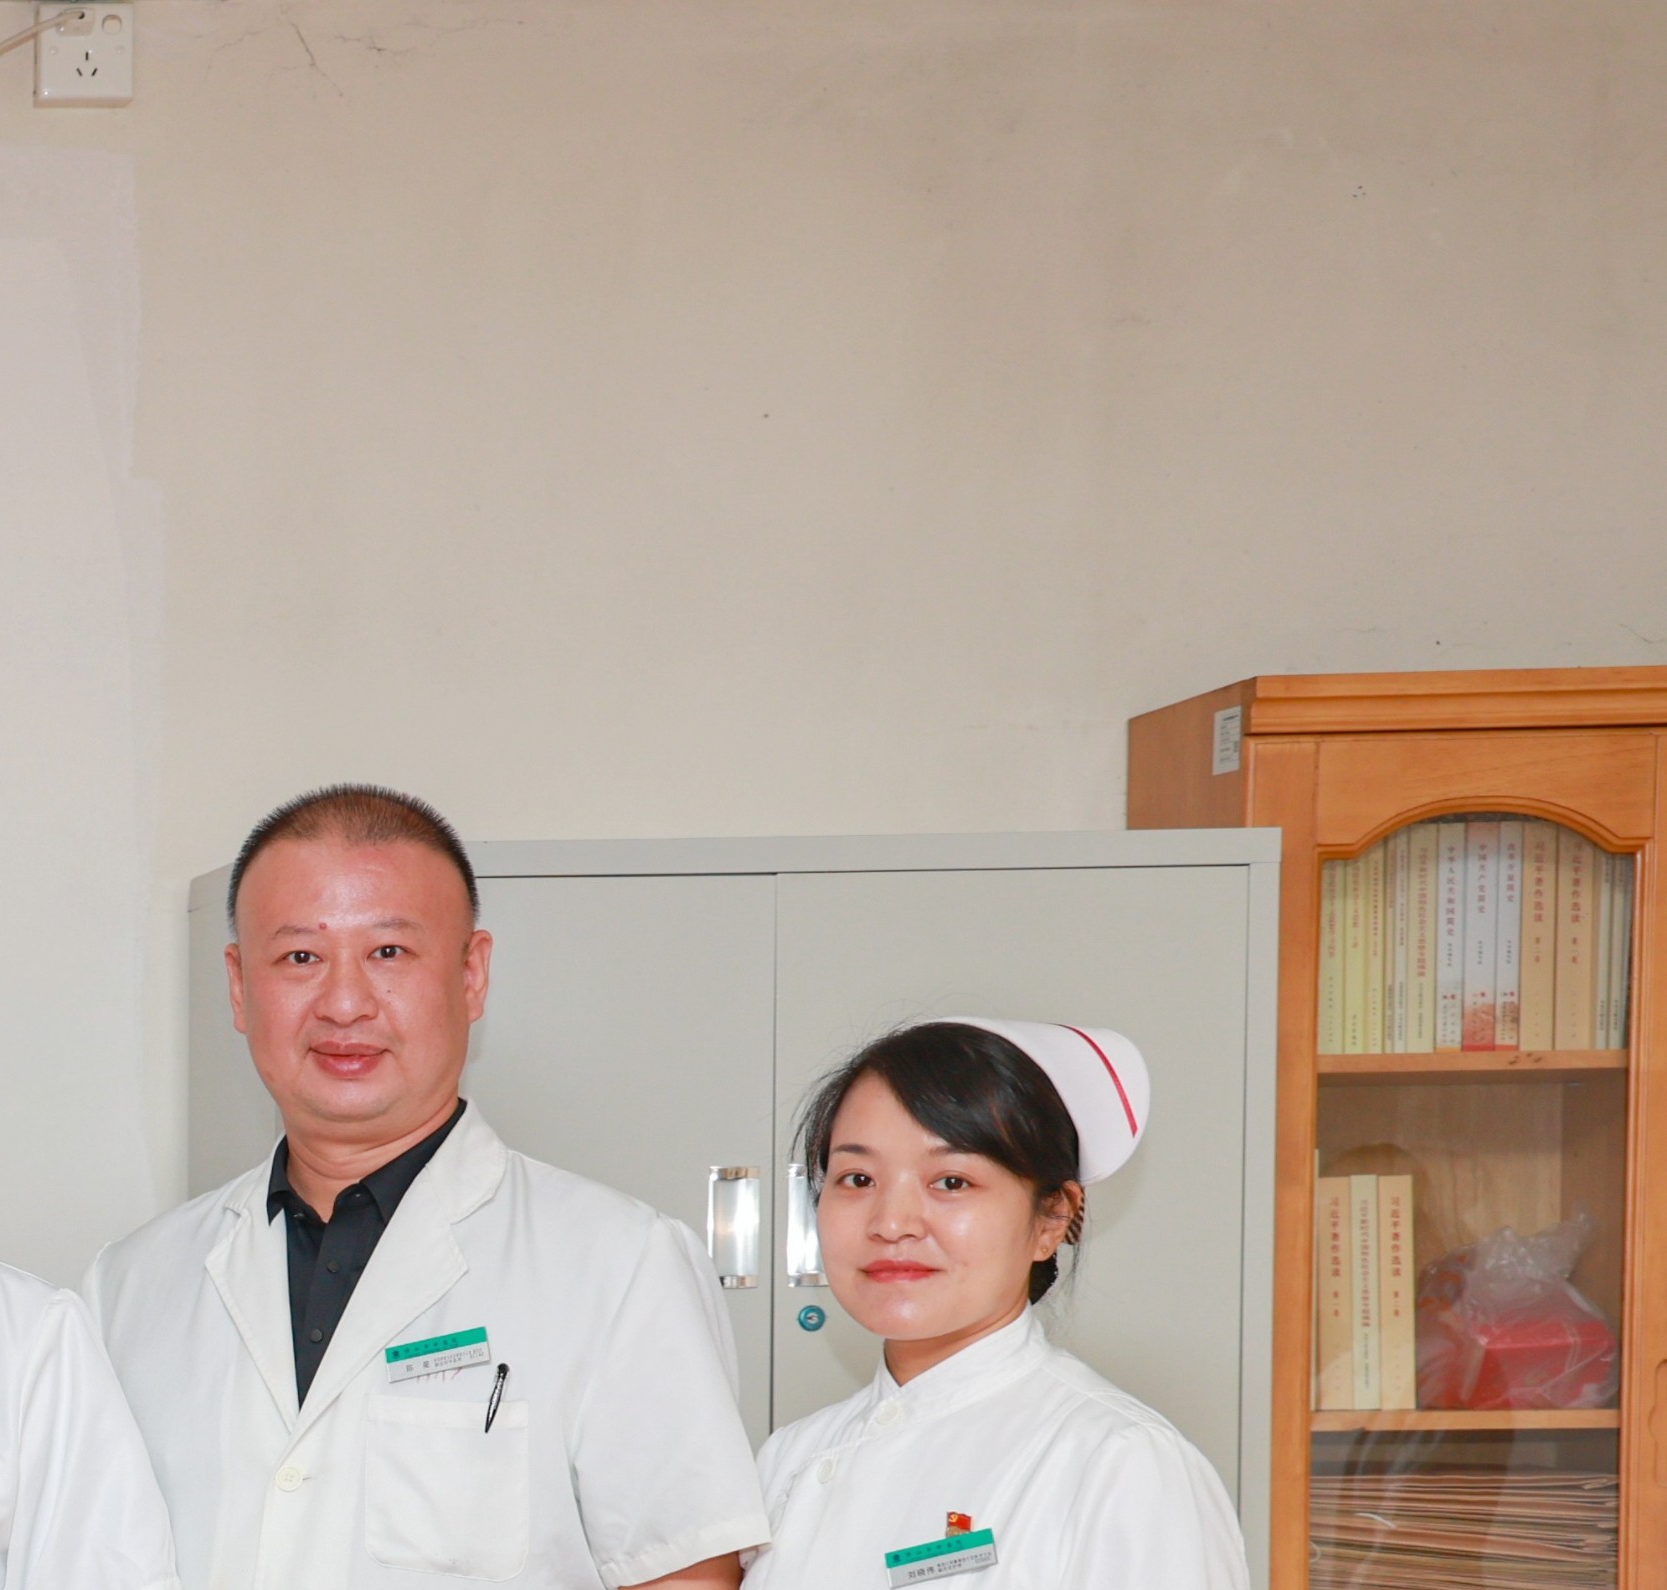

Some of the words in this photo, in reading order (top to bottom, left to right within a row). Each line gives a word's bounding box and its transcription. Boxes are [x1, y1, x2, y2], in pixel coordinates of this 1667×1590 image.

[1329, 1196, 1341, 1278] 习近平著作选读
[1390, 1196, 1402, 1277] 习近平著作选读
